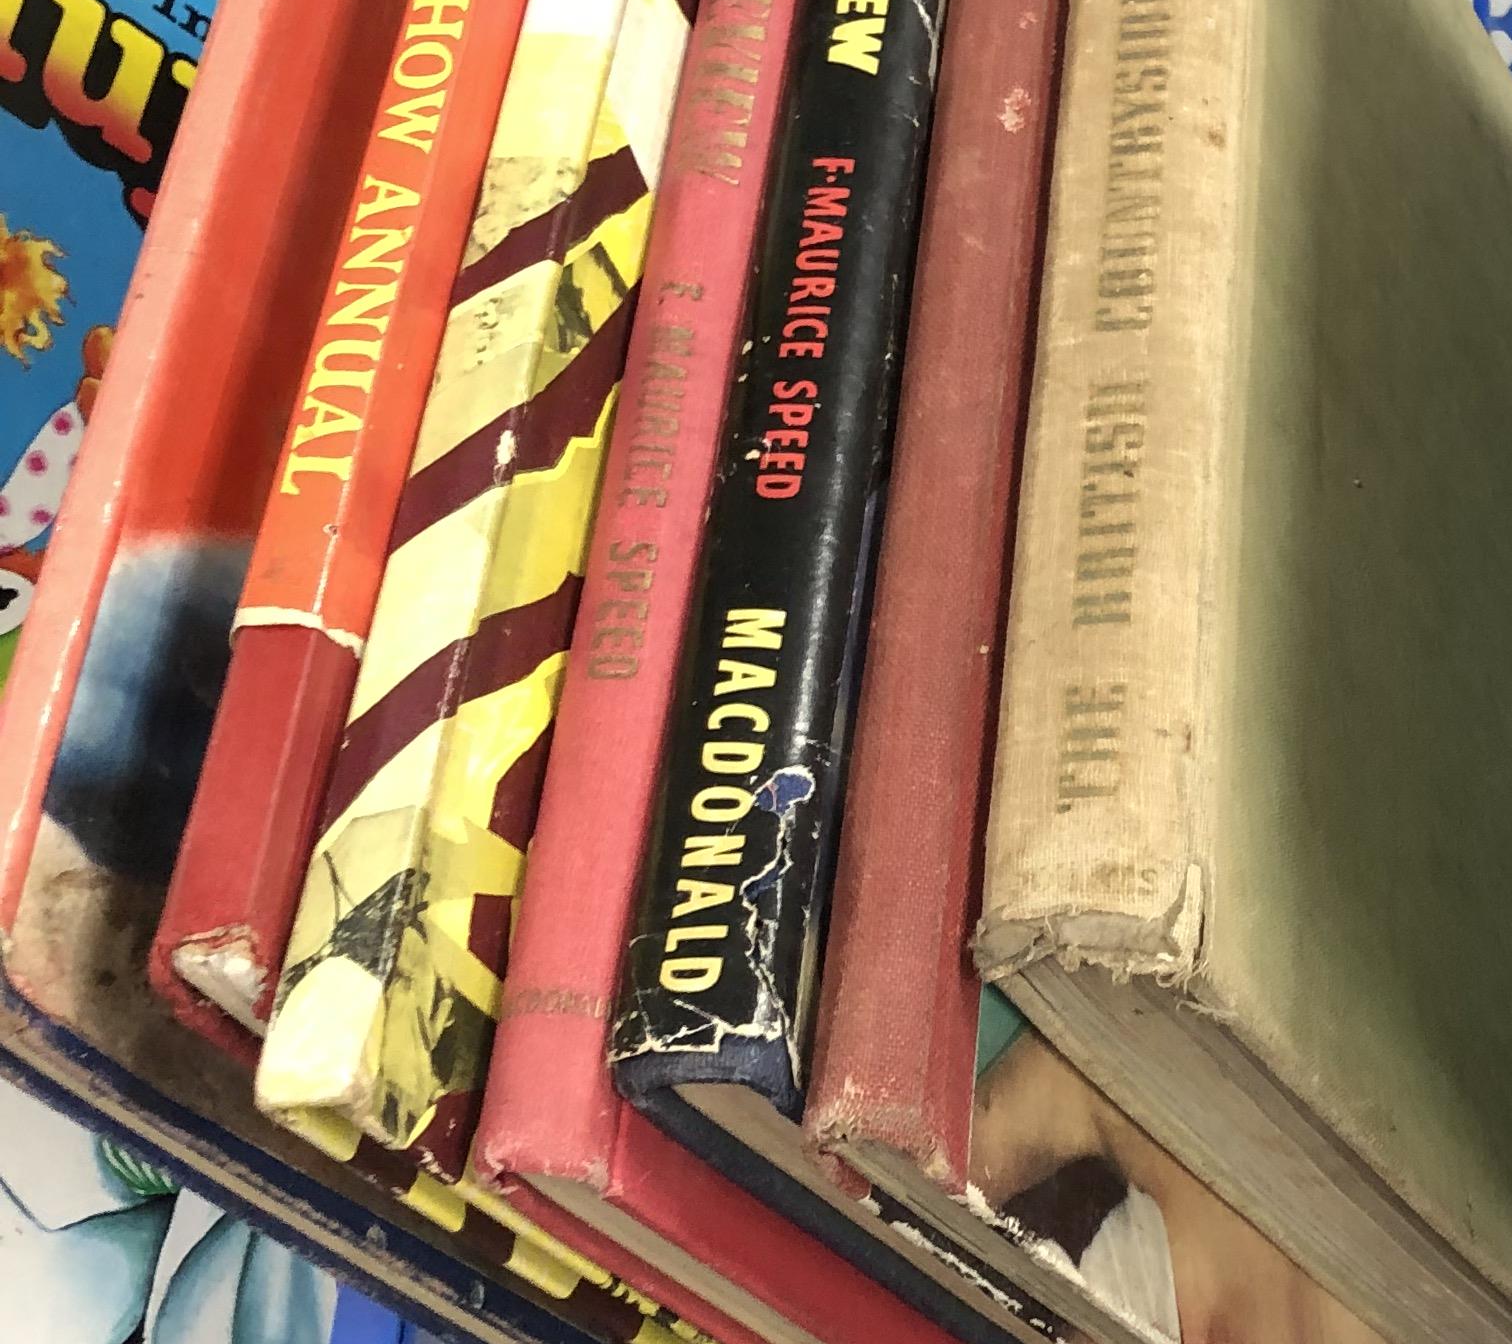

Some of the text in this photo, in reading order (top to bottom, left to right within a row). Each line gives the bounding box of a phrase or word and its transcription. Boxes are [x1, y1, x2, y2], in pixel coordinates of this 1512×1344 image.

[279, 174, 421, 495] ANNUAL
[617, 325, 695, 509] MAURICE
[755, 380, 819, 501] SPEED
[1072, 380, 1148, 626] BRITISH
[587, 540, 659, 681] SPEED
[658, 607, 788, 994] MACDONALD
[1056, 684, 1126, 813] THE
